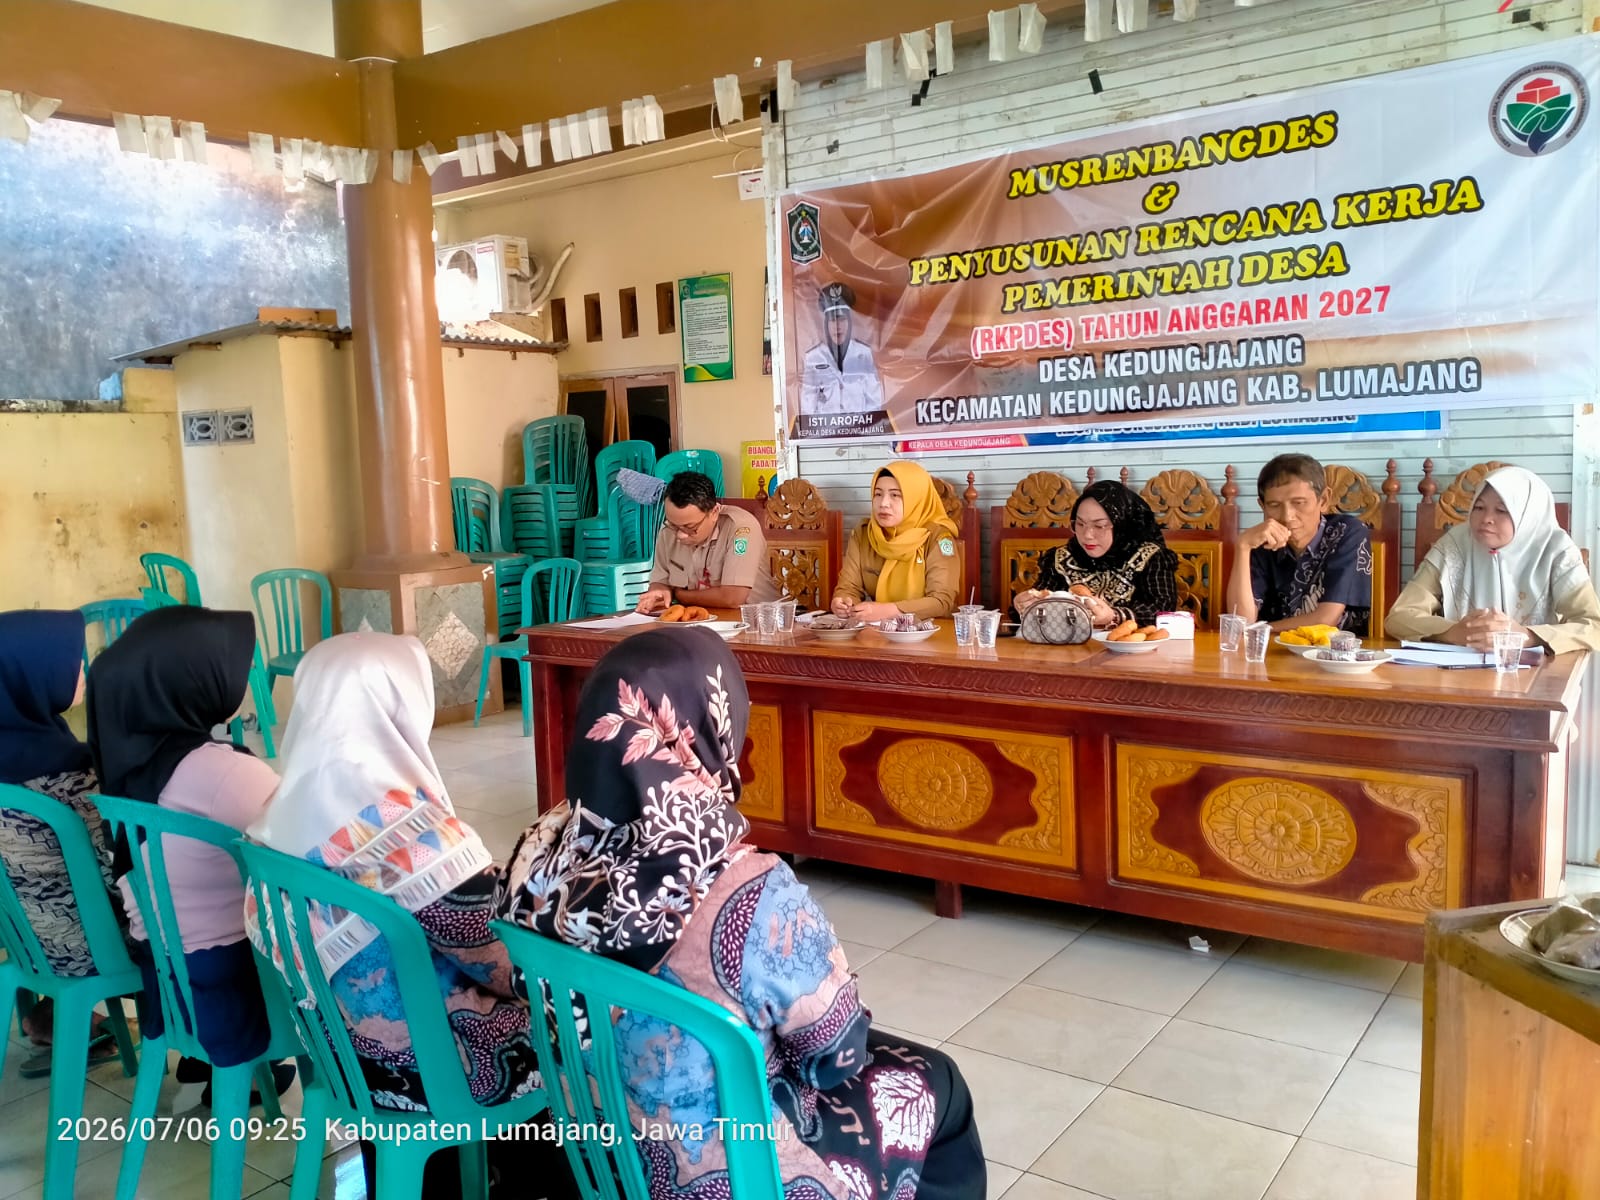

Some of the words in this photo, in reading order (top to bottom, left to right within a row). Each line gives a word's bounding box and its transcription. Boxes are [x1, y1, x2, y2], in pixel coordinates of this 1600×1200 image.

[1008, 111, 1339, 200] MUSRENBANGDES
[1142, 182, 1180, 214] &
[909, 227, 1131, 287] PENYUSUNAN
[1135, 199, 1325, 256] RENCANA
[1333, 176, 1485, 228] KERJA
[1001, 254, 1233, 314] PEMERINTAH
[1238, 242, 1349, 287] DESA
[970, 323, 1074, 357] (RKPDES)
[1081, 312, 1162, 342] TAHUN
[1167, 298, 1309, 334] ANGGARAN
[1318, 285, 1391, 317] 2027
[1037, 358, 1099, 384] DESA
[1103, 335, 1304, 380] KEDUNGJAJANG
[915, 394, 1042, 424] KECAMATAN
[1048, 381, 1239, 414] KEDUNGJAJANG
[1246, 372, 1312, 401] KAB.
[1317, 358, 1480, 398] LUMAJANG
[798, 429, 819, 437] KEPALA
[820, 428, 836, 436] DESA
[808, 416, 827, 427] ISTI
[830, 414, 873, 426] AROFAH
[908, 440, 934, 449] KEPALA
